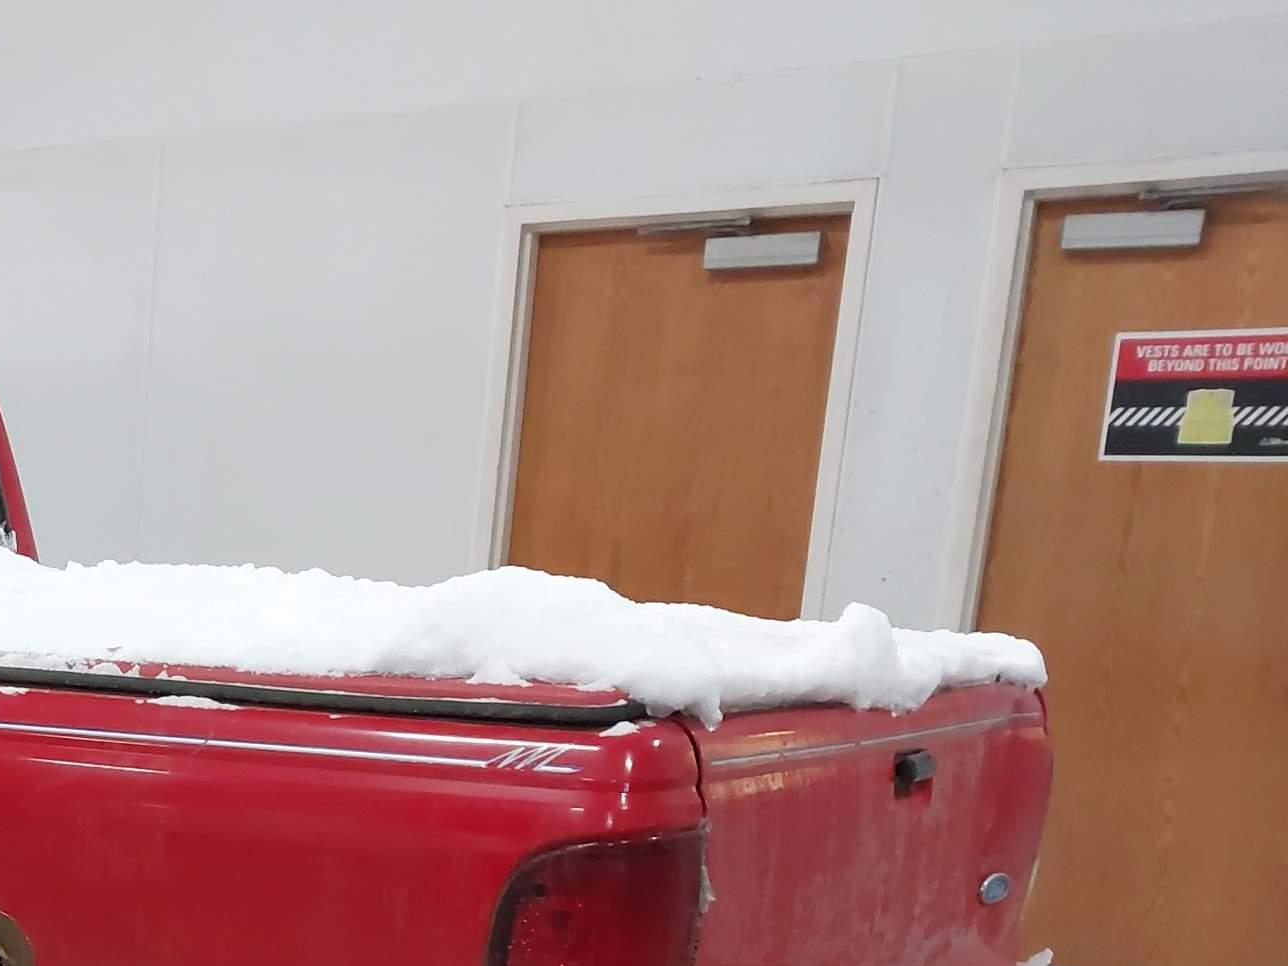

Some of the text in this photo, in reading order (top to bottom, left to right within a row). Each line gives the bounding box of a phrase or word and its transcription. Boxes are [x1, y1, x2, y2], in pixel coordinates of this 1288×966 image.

[1136, 345, 1180, 358] VESTS
[1182, 344, 1211, 357] ARE
[1214, 343, 1233, 356] TO
[1236, 342, 1257, 356] BE
[1147, 356, 1288, 372] BEYOND THIS POINT
